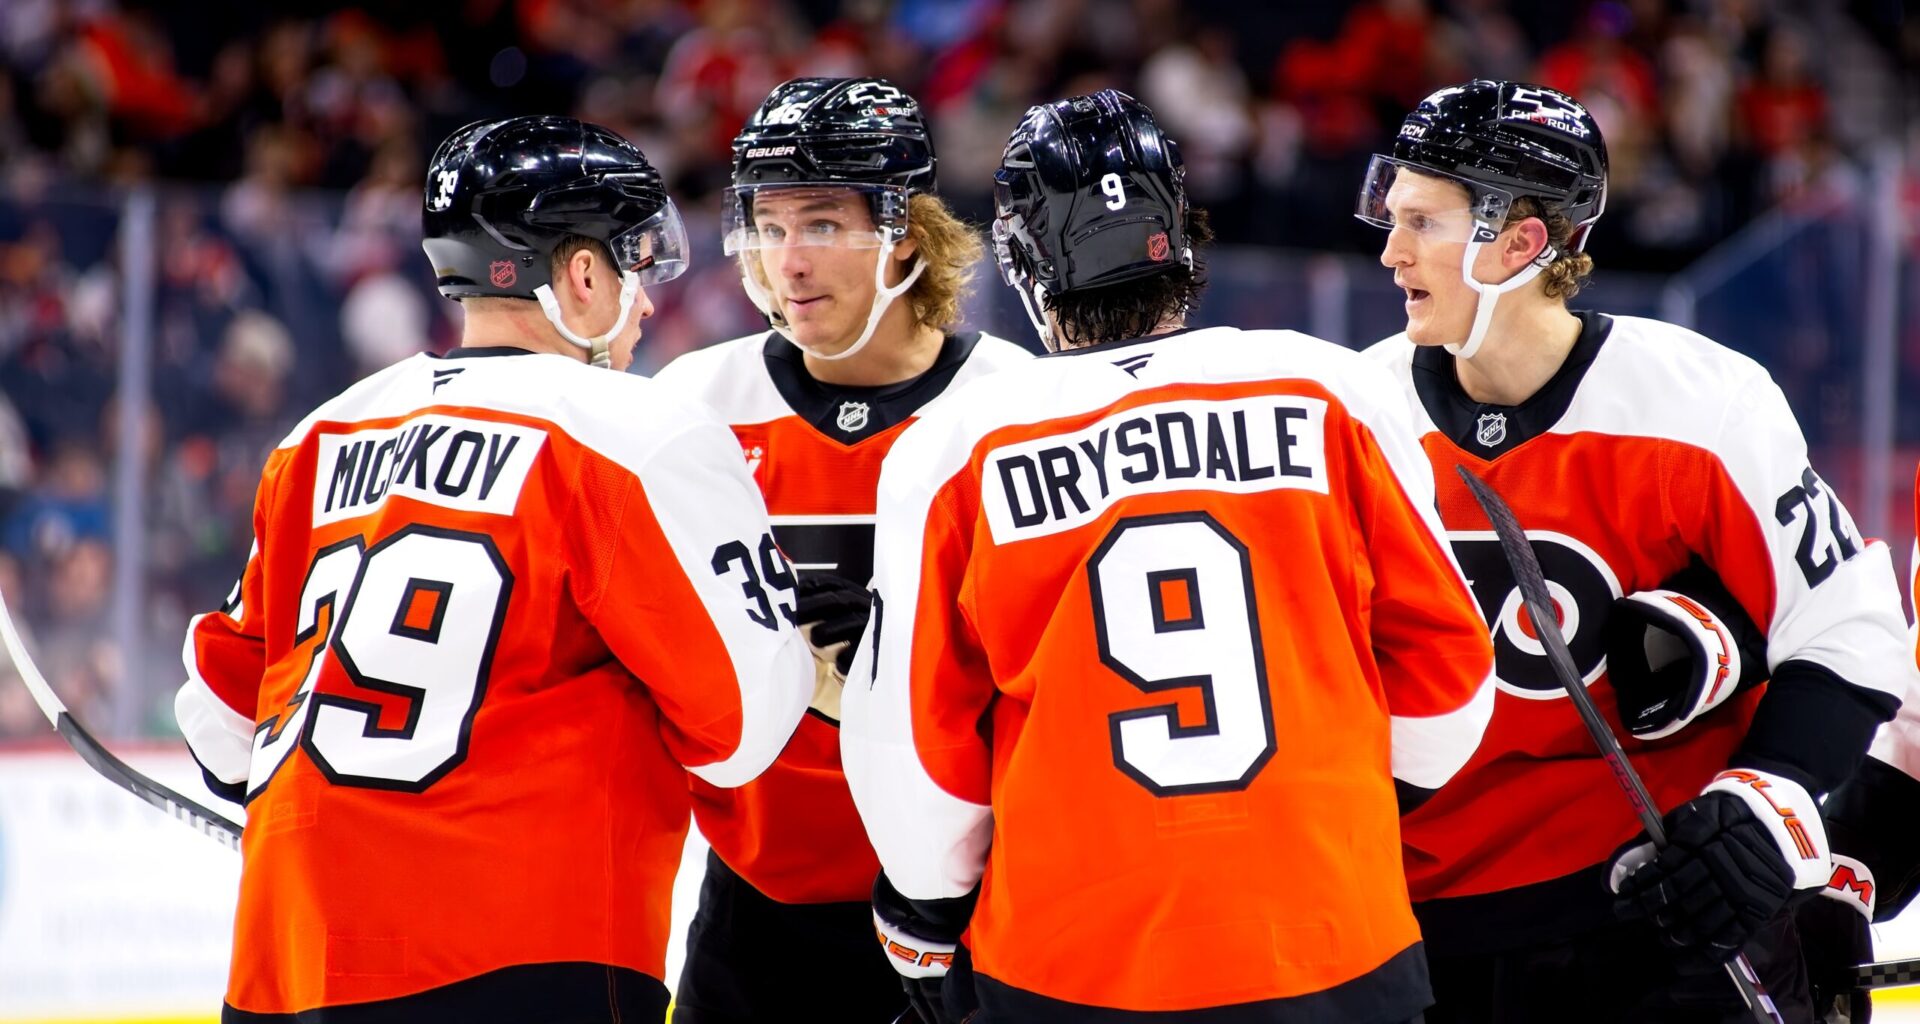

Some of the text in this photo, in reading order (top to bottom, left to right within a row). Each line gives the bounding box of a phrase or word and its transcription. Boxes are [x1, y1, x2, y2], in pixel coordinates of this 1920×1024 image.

[860, 106, 912, 117] CHEVROLET
[1400, 123, 1427, 138] CCM
[1511, 109, 1590, 140] CHEVROLET
[746, 145, 797, 158] BAUER
[434, 170, 459, 209] 39
[1101, 172, 1127, 211] 9
[324, 424, 520, 514] MICHKOV
[996, 406, 1313, 529] DRYSDALE
[711, 532, 799, 632] 39
[244, 522, 515, 806] 39
[1086, 510, 1278, 798] 9
